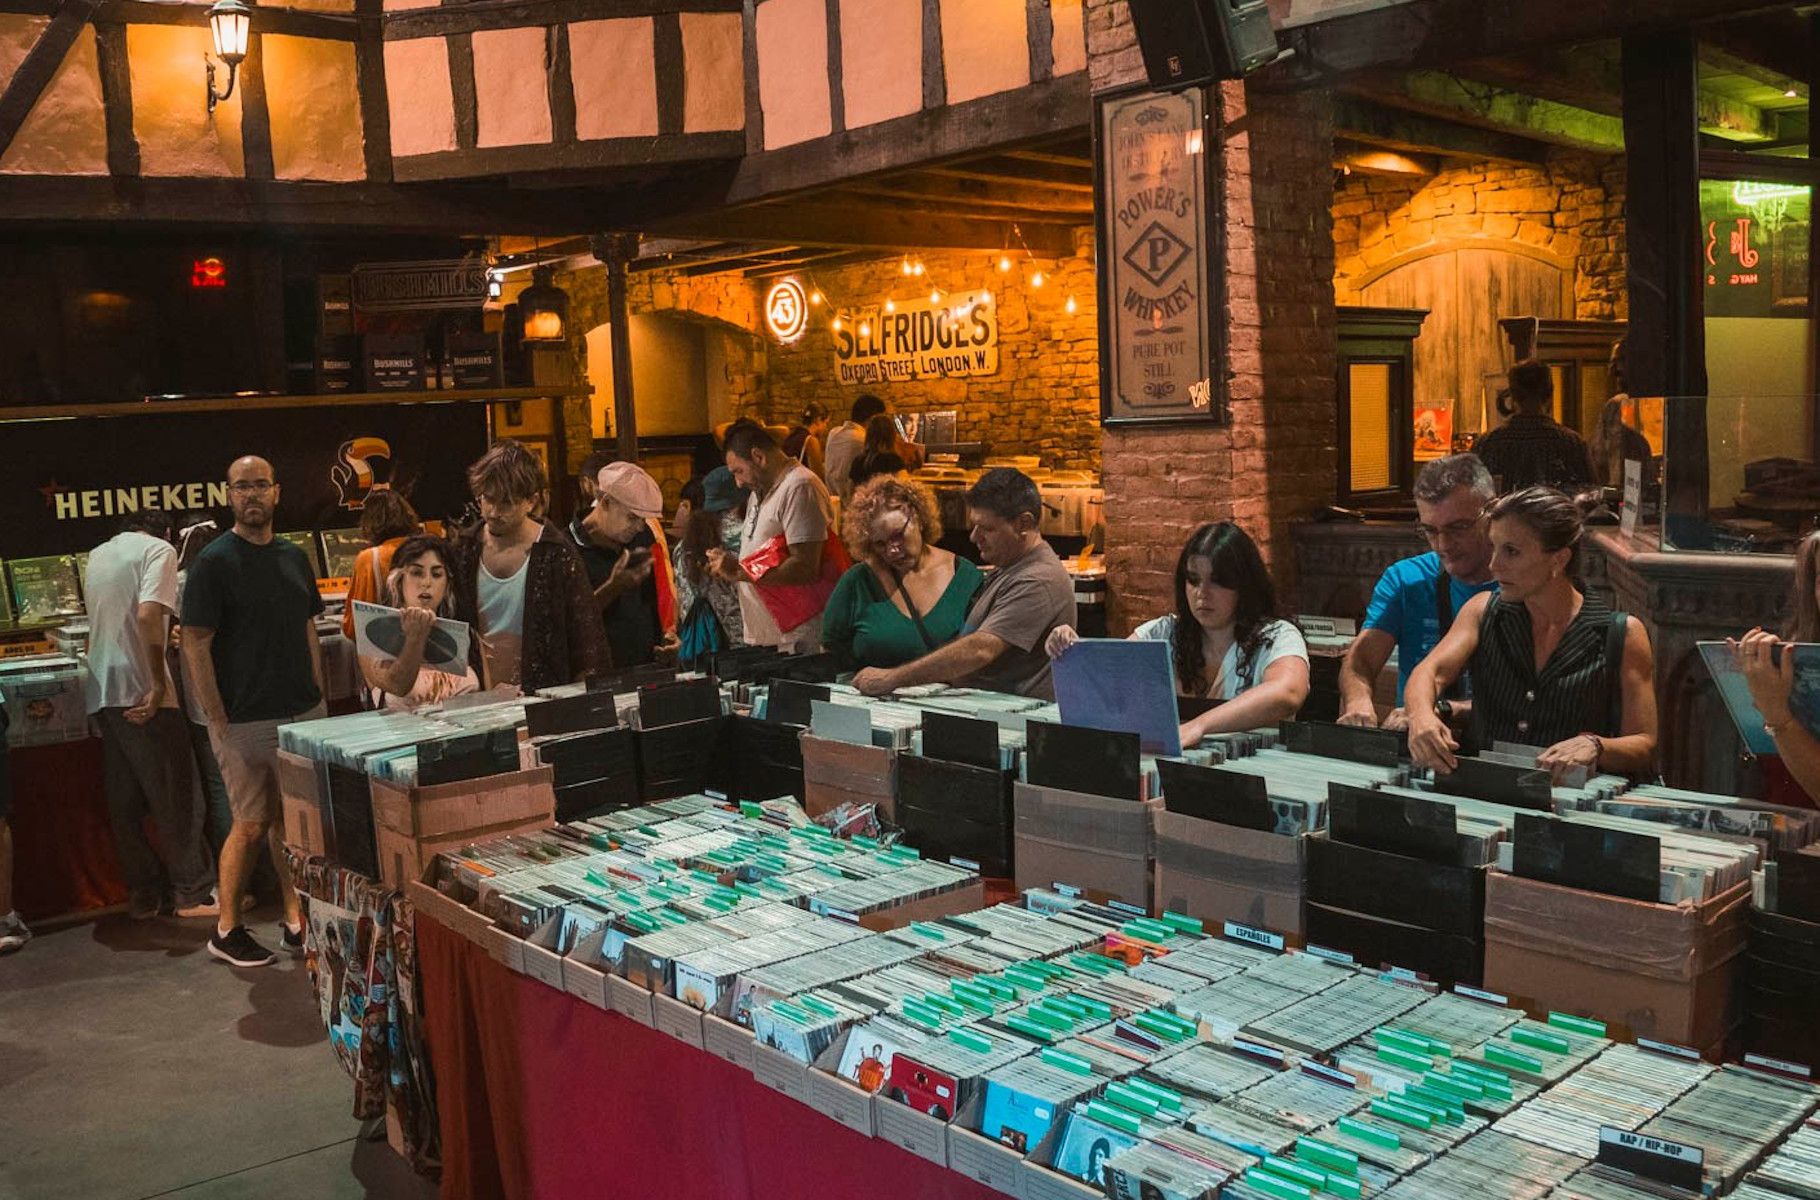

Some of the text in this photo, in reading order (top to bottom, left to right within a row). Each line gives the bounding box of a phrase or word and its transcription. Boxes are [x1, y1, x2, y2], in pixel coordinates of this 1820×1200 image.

[1118, 187, 1191, 229] POWER'S
[1147, 237, 1170, 272] P
[362, 273, 485, 297] BUSHMILLS
[772, 298, 794, 325] 43
[1123, 281, 1196, 321] WHISKEY
[836, 296, 990, 360] SELFRIDGE'S
[453, 355, 492, 367] BUSHMILLS
[1132, 340, 1186, 359] PURE POT
[373, 358, 415, 369] BUSHMILLS
[841, 362, 877, 381] OXFORD
[879, 358, 916, 379] STREET
[1143, 362, 1175, 380] STILL
[55, 481, 228, 520] HEINEKEN
[1236, 928, 1271, 944] ESPAÑOLES
[1619, 1132, 1637, 1145] RAP
[1645, 1138, 1683, 1157] HIP-HOP
